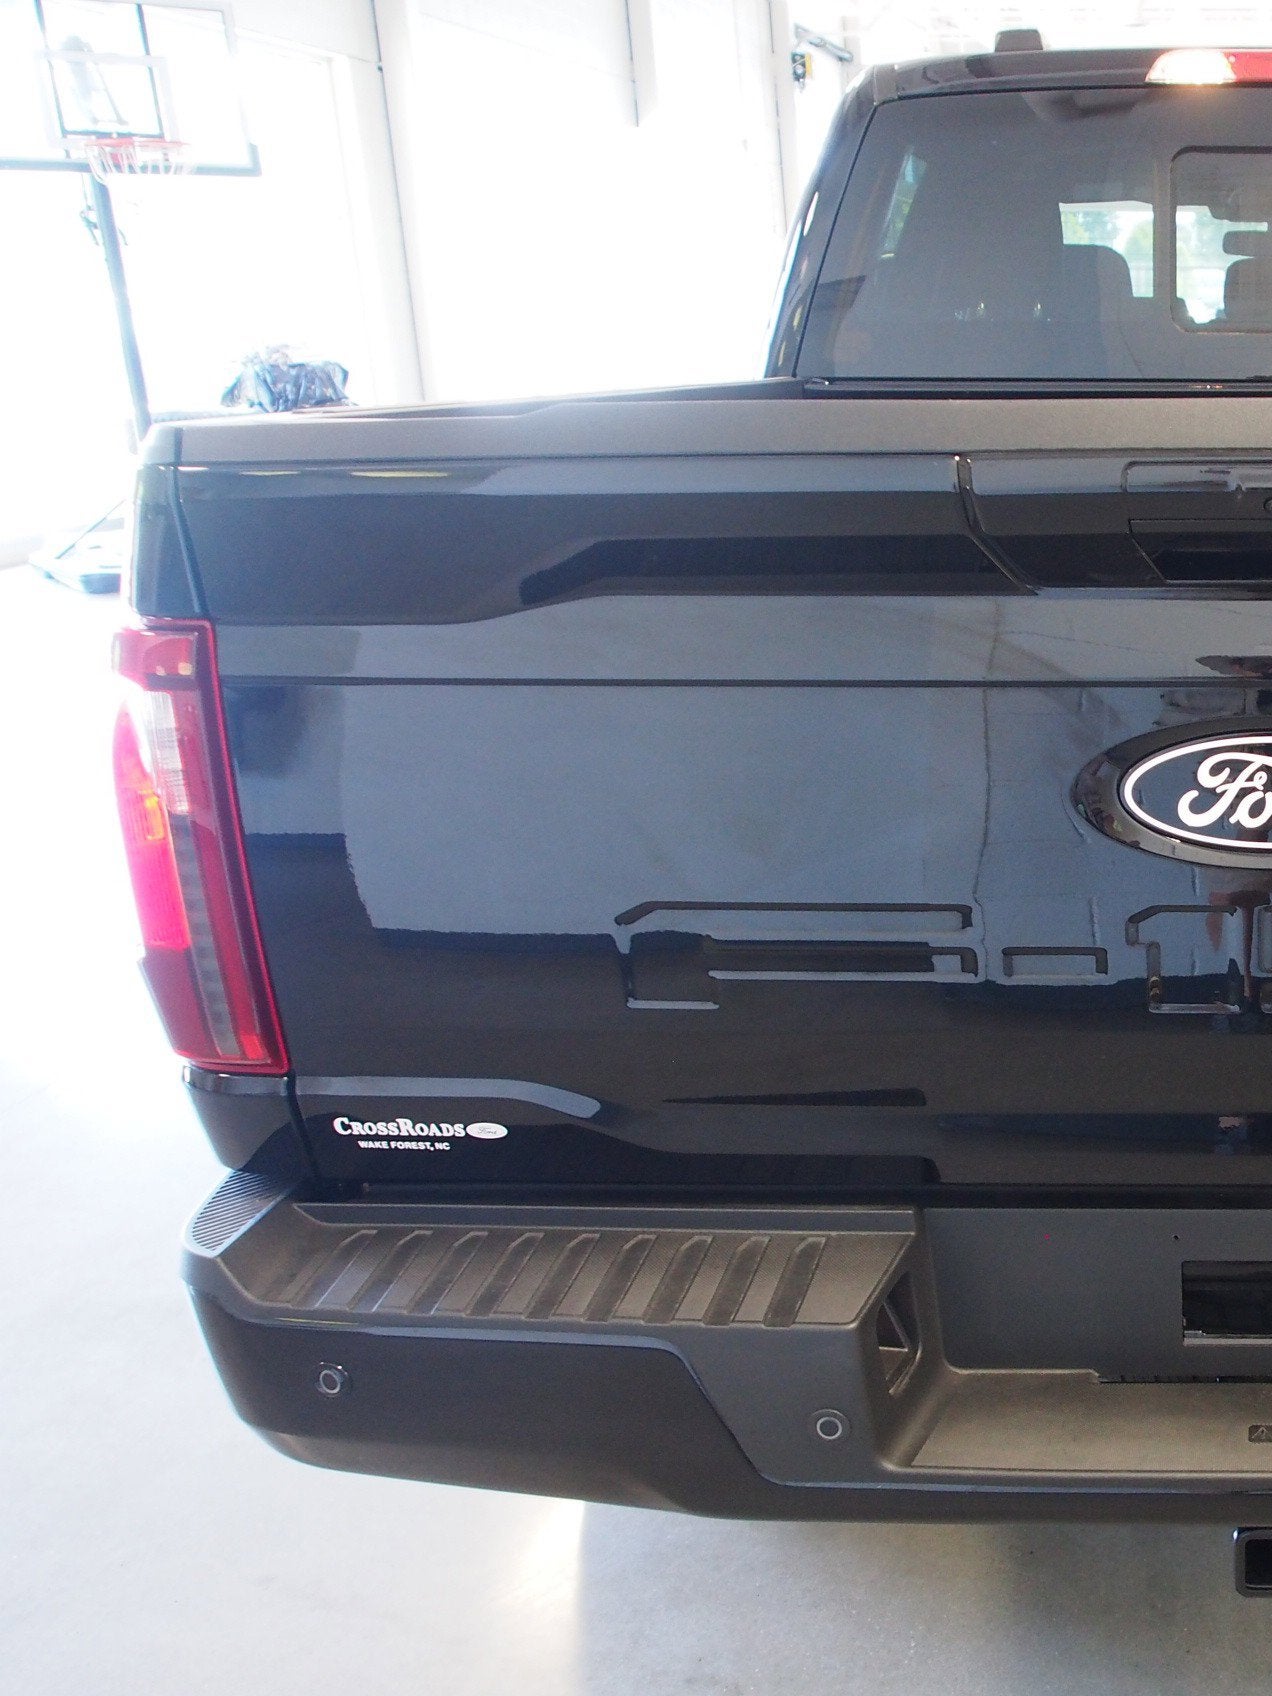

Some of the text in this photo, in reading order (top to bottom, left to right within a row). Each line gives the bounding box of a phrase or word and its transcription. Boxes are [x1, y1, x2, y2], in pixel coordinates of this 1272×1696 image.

[357, 1140, 451, 1151] WAKE FOREST, NC
